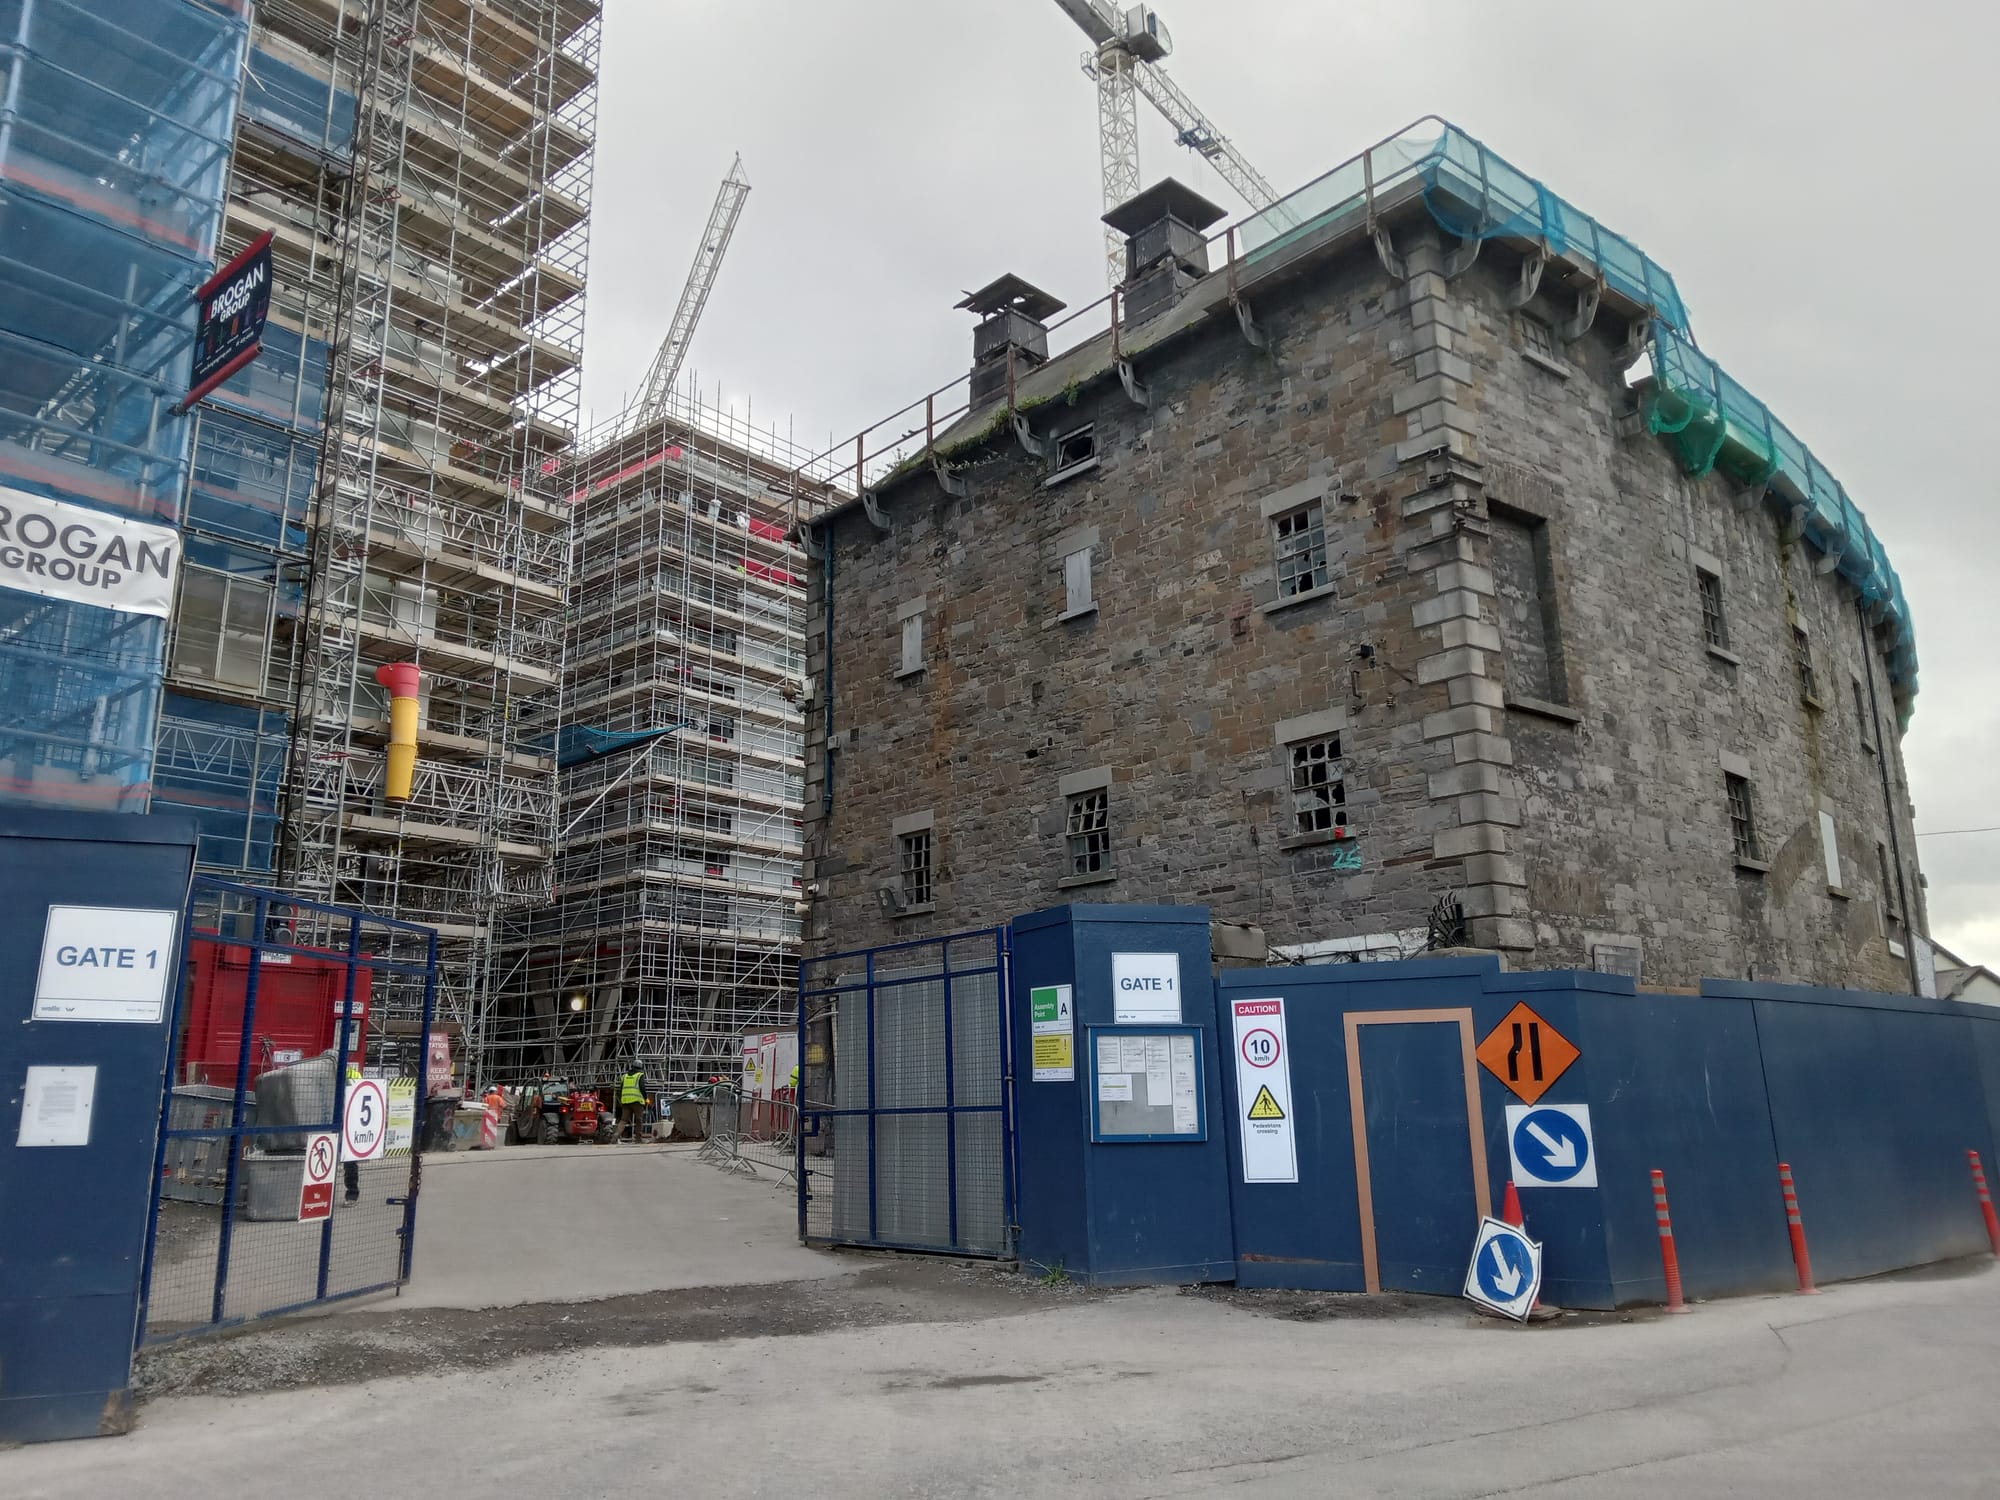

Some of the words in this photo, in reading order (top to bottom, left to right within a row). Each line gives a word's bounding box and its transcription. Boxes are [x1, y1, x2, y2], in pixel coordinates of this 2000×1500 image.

[210, 262, 264, 320] BROGAN
[219, 292, 250, 323] GROUP
[0, 546, 122, 590] GROUP
[56, 945, 136, 969] GATE
[146, 949, 158, 970] 1
[1120, 977, 1162, 991] GATE
[1166, 977, 1174, 991] 1
[1034, 1002, 1055, 1011] Assembly
[1060, 1002, 1068, 1016] A
[1238, 1004, 1277, 1014] CAUTION!
[1250, 1039, 1270, 1054] 10
[360, 1095, 372, 1127] 5
[353, 1130, 374, 1144] km/h
